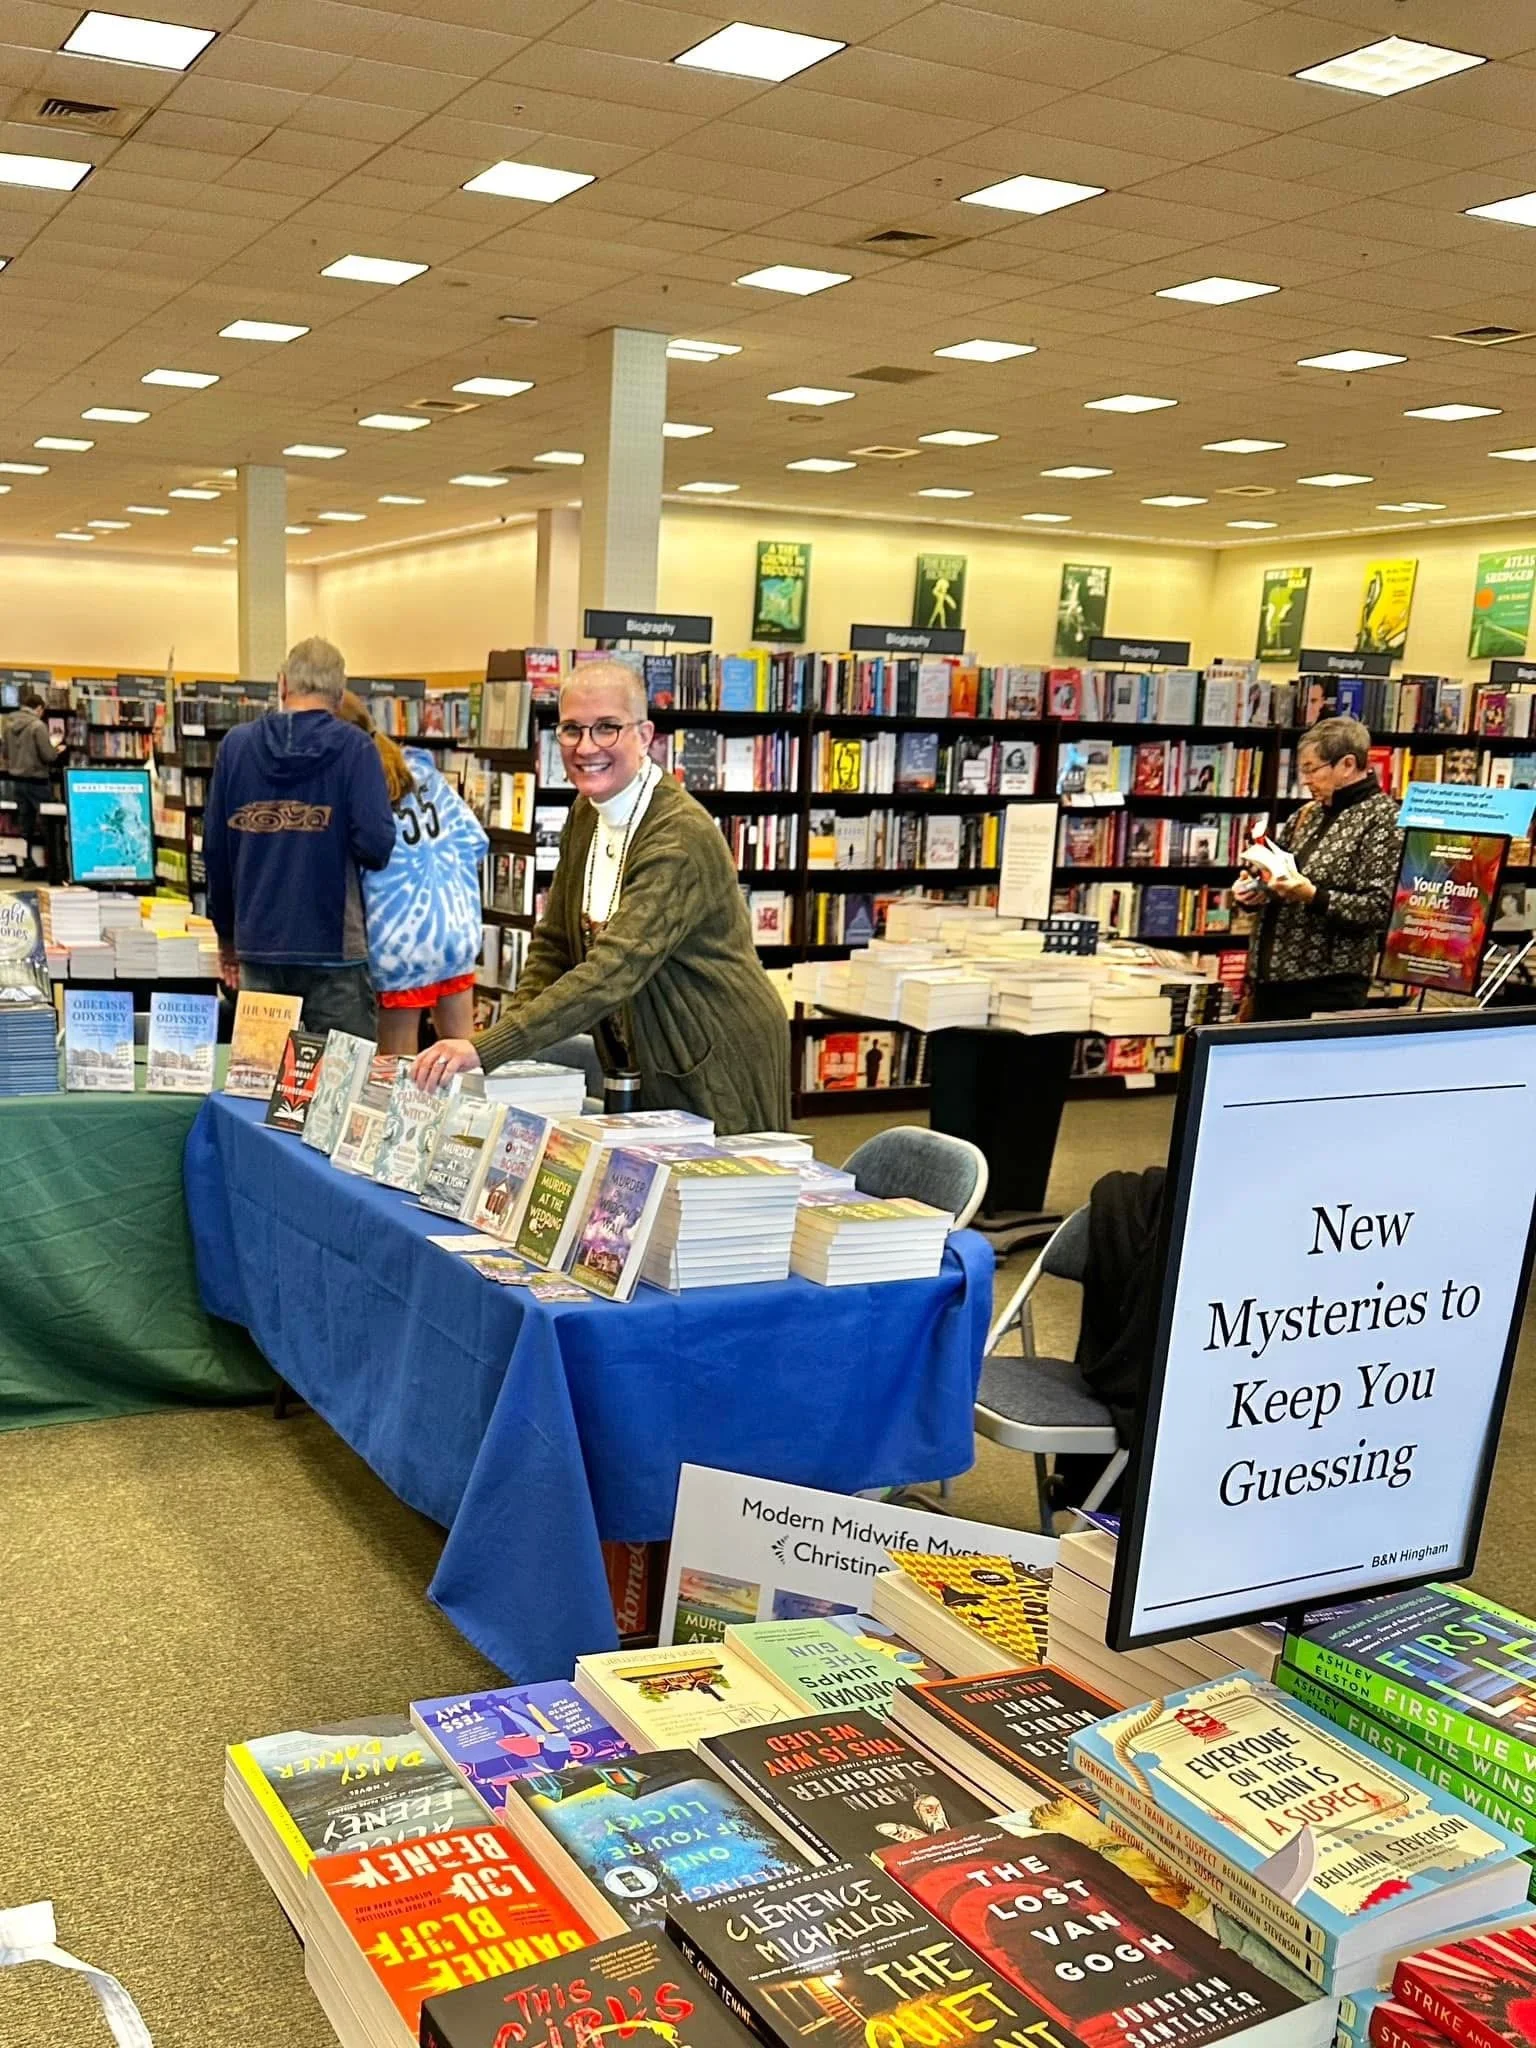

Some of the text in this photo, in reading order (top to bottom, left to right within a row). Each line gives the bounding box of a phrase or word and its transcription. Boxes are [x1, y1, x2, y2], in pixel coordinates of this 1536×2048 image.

[626, 619, 676, 637] Biography
[1408, 894, 1450, 910] on Art
[1413, 876, 1479, 898] Your Brain
[72, 1011, 128, 1023] ODYSSEY
[73, 999, 127, 1011] OBELISK
[156, 1014, 208, 1026] ODYSSEY
[157, 1002, 209, 1013] OBELISK
[442, 1142, 476, 1160] MURDER
[446, 1175, 470, 1188] LIGHT
[541, 1175, 573, 1196] MURDER
[611, 1172, 646, 1193] MURDER
[529, 1205, 563, 1230] WEDDING
[538, 1192, 565, 1212] AT THE
[1307, 1203, 1415, 1255] New
[1203, 1279, 1481, 1359] Mysteries to
[1226, 1362, 1436, 1430] Keep You
[1219, 1438, 1418, 1507] Guessing
[743, 1497, 920, 1552] Modern Midwife
[793, 1542, 891, 1577] Christine
[1371, 1542, 1449, 1568] B&N Hingham
[685, 1614, 727, 1633] MURD
[786, 1641, 840, 1658] GUN
[819, 1652, 872, 1669] THE
[1375, 1614, 1509, 1677] FIRST
[798, 1665, 877, 1689] JUMPS
[1315, 1664, 1371, 1698] ELSTON
[1316, 1651, 1373, 1683] ASHLEY
[434, 1699, 472, 1722] AMY
[960, 1681, 1053, 1704] NINA SIMON
[992, 1695, 1065, 1718] NIGHT
[1293, 1678, 1341, 1710] ASHLEY
[440, 1711, 485, 1734] TESS
[765, 1723, 864, 1753] WE LIED
[1006, 1709, 1099, 1738] MURDER
[1383, 1686, 1456, 1734] FIRST
[1466, 1725, 1510, 1762] LIE
[272, 1739, 383, 1779] DARKER
[341, 1750, 426, 1785] DAISY
[763, 1737, 905, 1777] THIS IS WHY
[1184, 1727, 1301, 1780] EVERYONE
[1228, 1752, 1308, 1787] ON THIS
[348, 1783, 381, 1796] NOVEL
[787, 1760, 936, 1801] SLAUGHTER
[1239, 1766, 1340, 1811] TRAIN IS
[1348, 1714, 1407, 1758] FIRST
[1415, 1757, 1452, 1790] LIE
[1463, 1783, 1526, 1836] WINS
[1472, 1754, 1536, 1805] WINS
[841, 1782, 915, 1811] KARIN
[1265, 1782, 1380, 1836] A SUSPECT
[323, 1790, 454, 1845] FEENEY
[602, 1800, 709, 1837] LUCKY
[607, 1820, 741, 1860] IF YOU'RE
[1080, 1755, 1114, 1788] EVERYONE
[1127, 1791, 1142, 1810] THIS
[1144, 1803, 1165, 1829] TRAIN
[1166, 1821, 1174, 1835] IS
[1184, 1835, 1217, 1868] SUSPECT
[1222, 1864, 1258, 1900] BENJAMIN
[1260, 1893, 1301, 1931] STEVENSON
[1110, 1819, 1144, 1855] EVERYONE
[1313, 1849, 1391, 1889] BENJAMIN
[1386, 1818, 1469, 1857] STEVENSON
[336, 1832, 509, 1889] BERNEY
[659, 1847, 731, 1873] ONLY
[965, 1855, 1050, 1888] THE
[441, 1864, 536, 1905] LOU
[696, 1863, 854, 1913] NATIONAL BESTSELLER
[987, 1878, 1091, 1920] LOST
[726, 1879, 882, 1942] CLÉMENCE
[1030, 1910, 1121, 1947] VAN
[1194, 1861, 1225, 1894] SUSPECT
[1229, 1891, 1261, 1926] BENJAMIN
[1263, 1920, 1302, 1960] STEVENSON
[366, 1906, 507, 1967] BLUFF
[755, 1900, 915, 1963] MICHALLON
[864, 1941, 974, 2000] THE
[1055, 1934, 1175, 1982] GOGH
[681, 1941, 751, 2026] THE QUIET TENANT
[1134, 1973, 1158, 1985] NOVEL
[493, 1982, 695, 2048] GIRL'S
[504, 1978, 592, 2024] THIS
[864, 1981, 1018, 2048] QUIET
[1111, 1976, 1232, 2029] JONATHAN
[1124, 1991, 1262, 2048] SANTLOFER
[1402, 1979, 1464, 2033] STRIKE
[1191, 2030, 1206, 2040] THE
[1208, 2022, 1226, 2034] LAST
[1249, 2007, 1267, 2020] LISA
